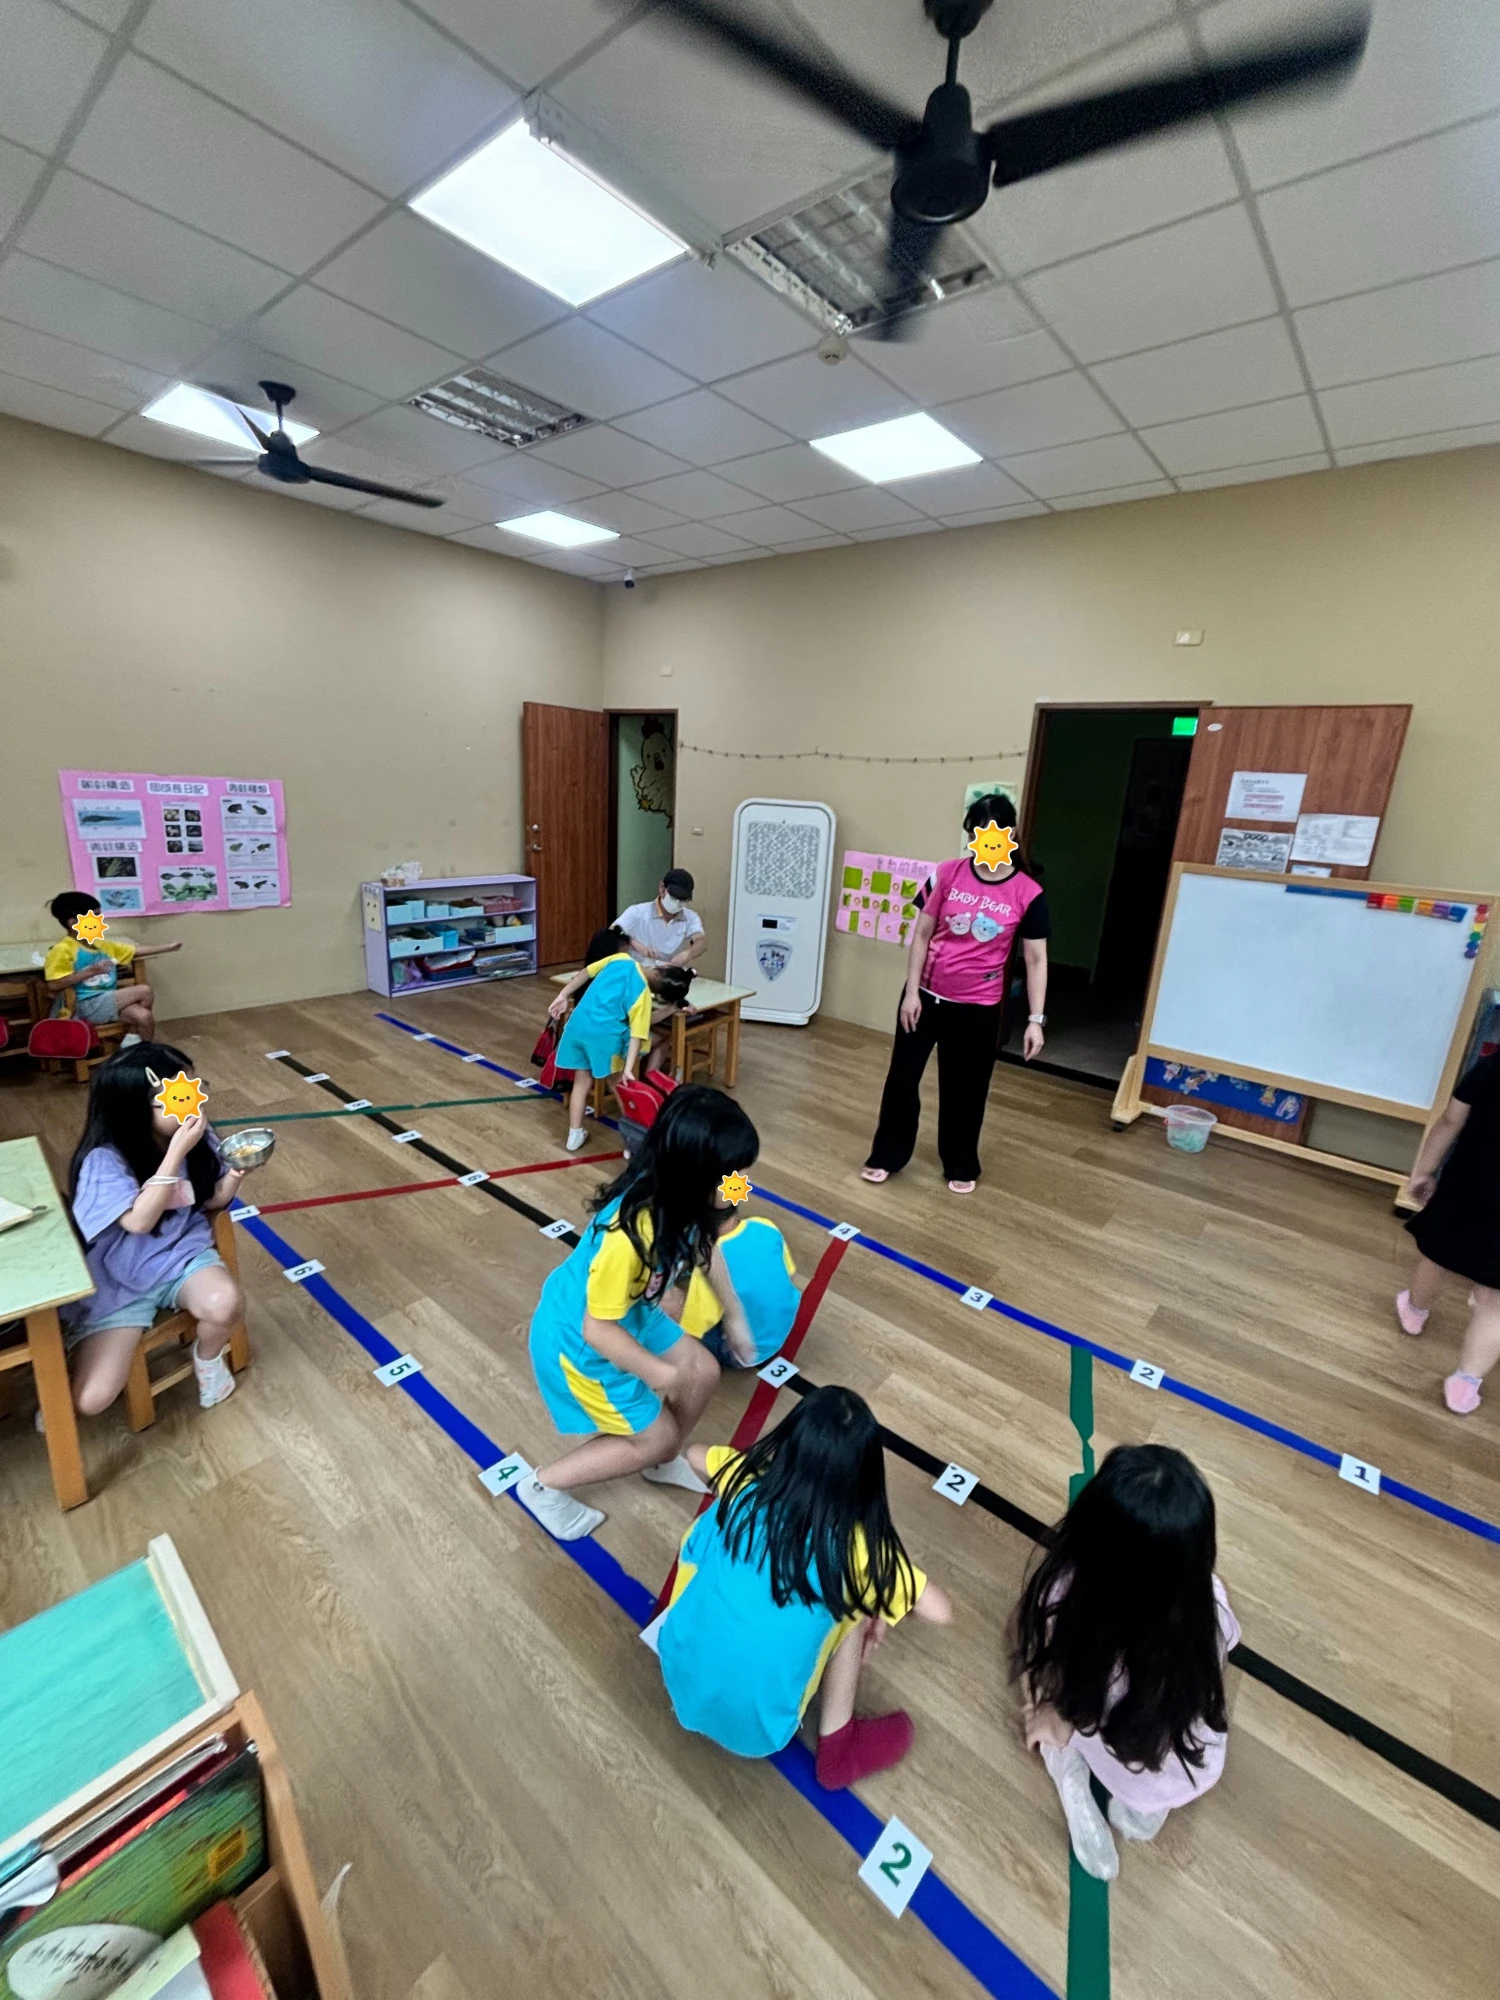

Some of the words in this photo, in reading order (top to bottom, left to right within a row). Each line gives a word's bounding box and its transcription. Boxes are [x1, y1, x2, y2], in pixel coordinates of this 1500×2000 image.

[948, 887, 980, 906] BABY
[979, 895, 1012, 917] BEAR
[467, 1174, 483, 1182] 6
[233, 1209, 252, 1218] 7
[551, 1224, 567, 1234] 5
[839, 1227, 851, 1236] 4
[293, 1266, 313, 1277] 6
[969, 1292, 985, 1303] 3
[389, 1362, 412, 1377] 5
[770, 1364, 788, 1378] 3
[1139, 1367, 1156, 1381] 2
[497, 1464, 520, 1482] 4
[1354, 1465, 1371, 1484] 1
[946, 1474, 967, 1493] 2
[878, 1841, 913, 1889] 2
